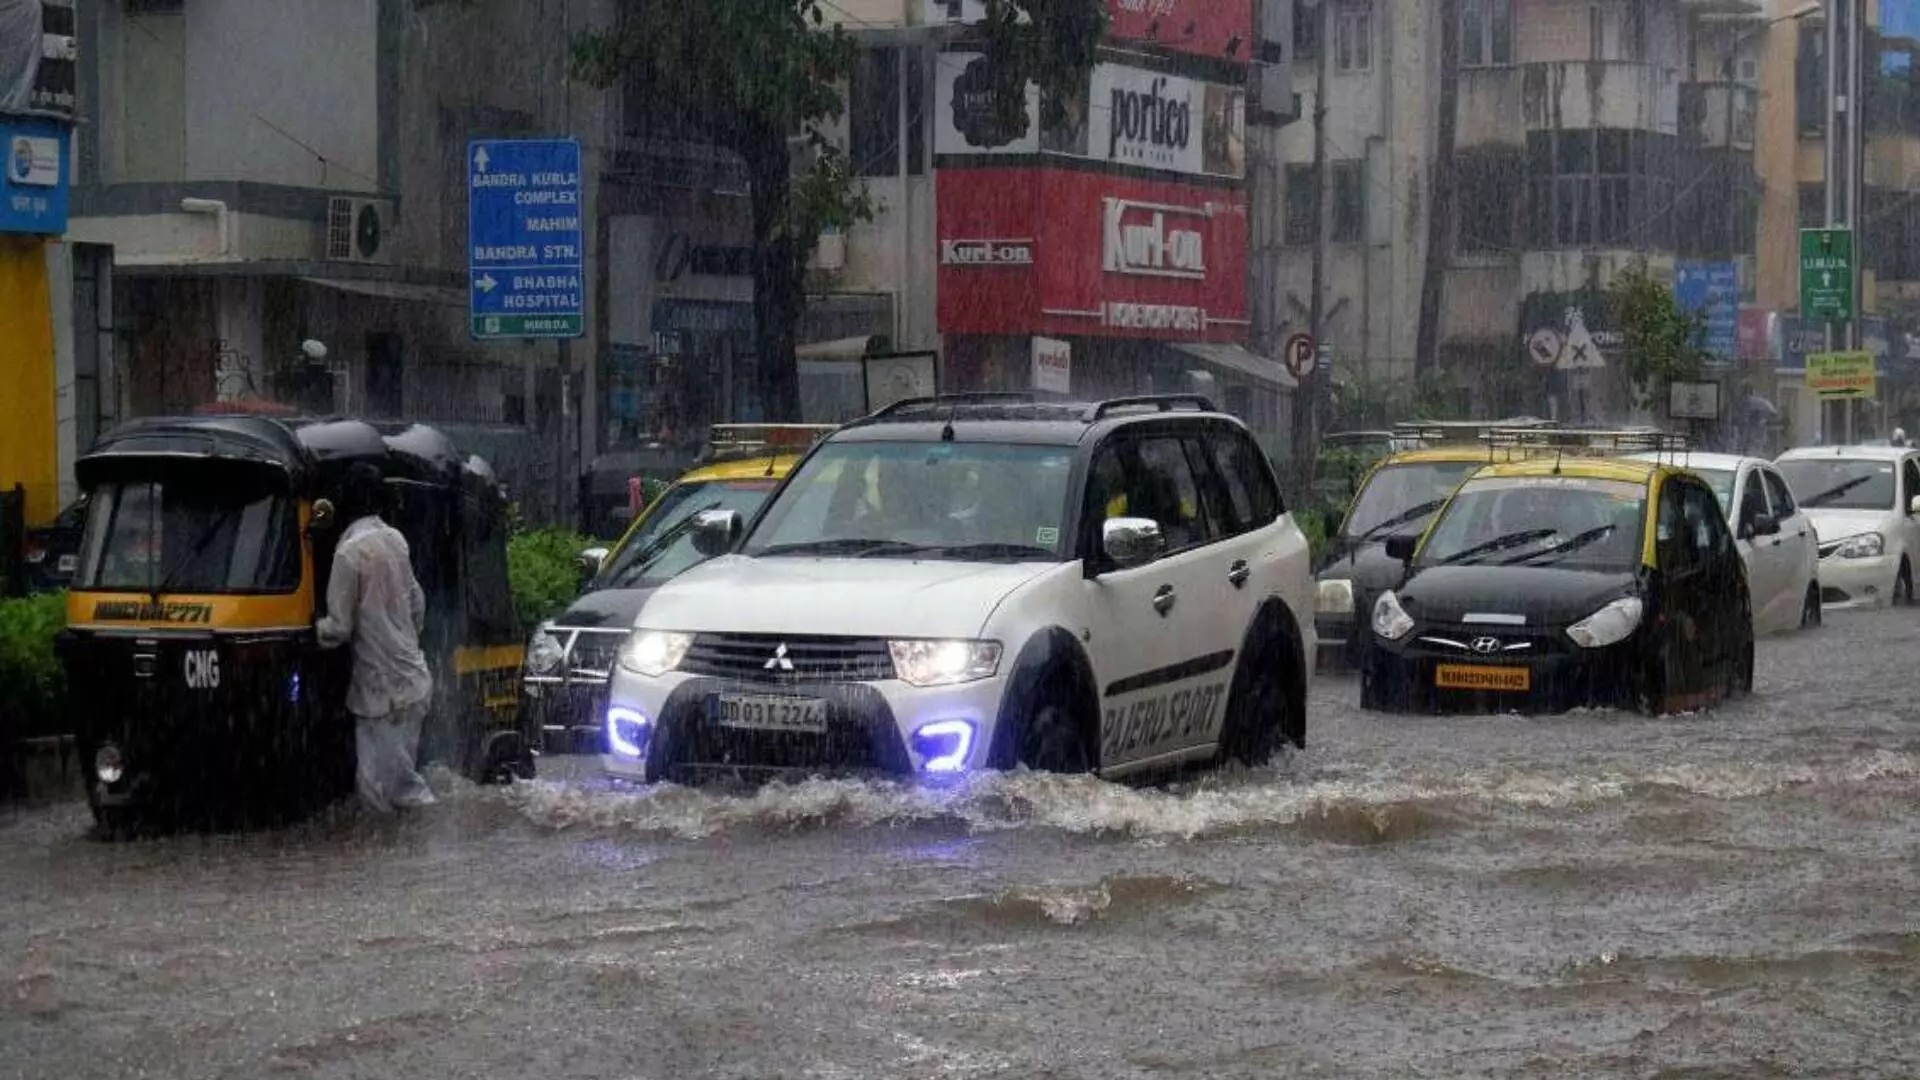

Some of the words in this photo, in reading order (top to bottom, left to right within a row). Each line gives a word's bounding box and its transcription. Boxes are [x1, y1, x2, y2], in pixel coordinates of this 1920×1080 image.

[1110, 77, 1191, 158] portico
[473, 173, 526, 187] BANDRA
[514, 191, 577, 204] COMPLEX
[527, 217, 578, 231] MAHIM
[1102, 197, 1206, 273] Kurl-on
[475, 246, 537, 260] BANDRA
[941, 239, 1033, 264] Kurl-on
[513, 276, 579, 289] BHABHA
[504, 294, 579, 308] HOSPITAL
[185, 649, 220, 688] CNG
[743, 702, 763, 722] 03
[1102, 694, 1167, 757] PAJERO
[1161, 683, 1225, 739] SPORT
